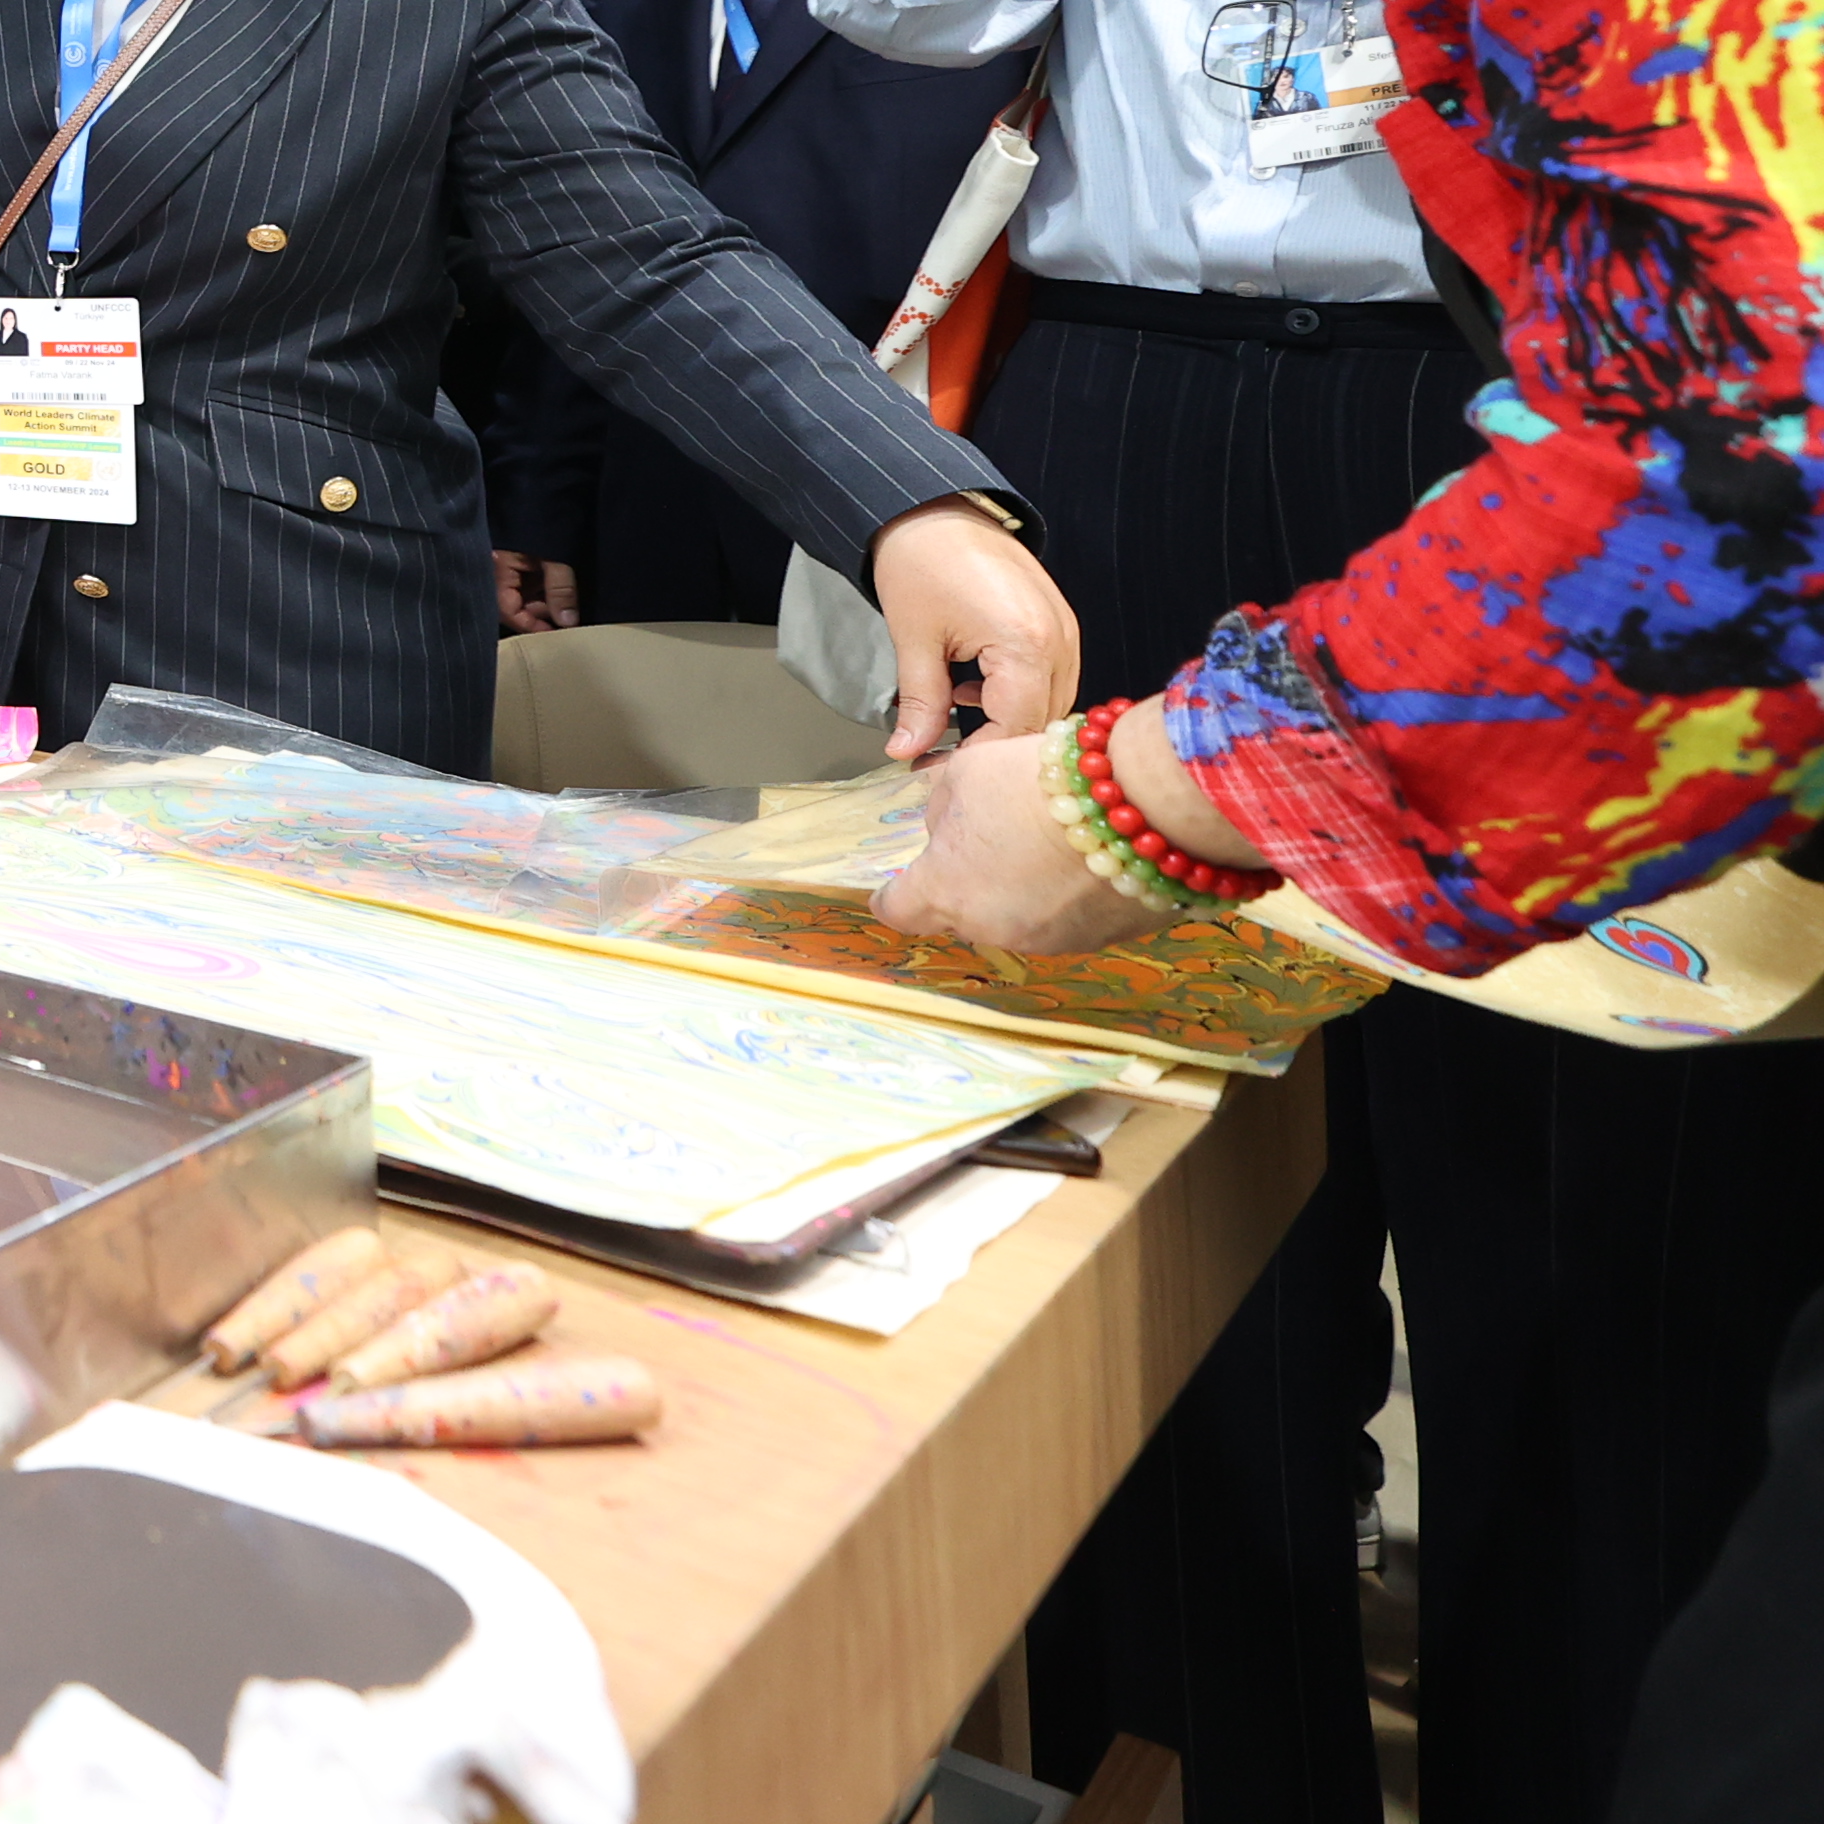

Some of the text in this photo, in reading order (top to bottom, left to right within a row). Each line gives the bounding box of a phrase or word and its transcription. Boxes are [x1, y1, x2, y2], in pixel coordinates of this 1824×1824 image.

[1371, 83, 1401, 97] PRE
[1315, 121, 1355, 134] Firuza
[90, 303, 132, 312] UNFCCC
[74, 312, 105, 321] Türkiye
[55, 344, 124, 354] PARTY HEAD
[29, 370, 92, 380] Fatma Varank
[3, 408, 115, 422] World Leaders Climate
[24, 421, 97, 433] Action Summit
[22, 462, 66, 475] GOLD
[8, 483, 110, 497] 12-13 NOVEMBER 2024
